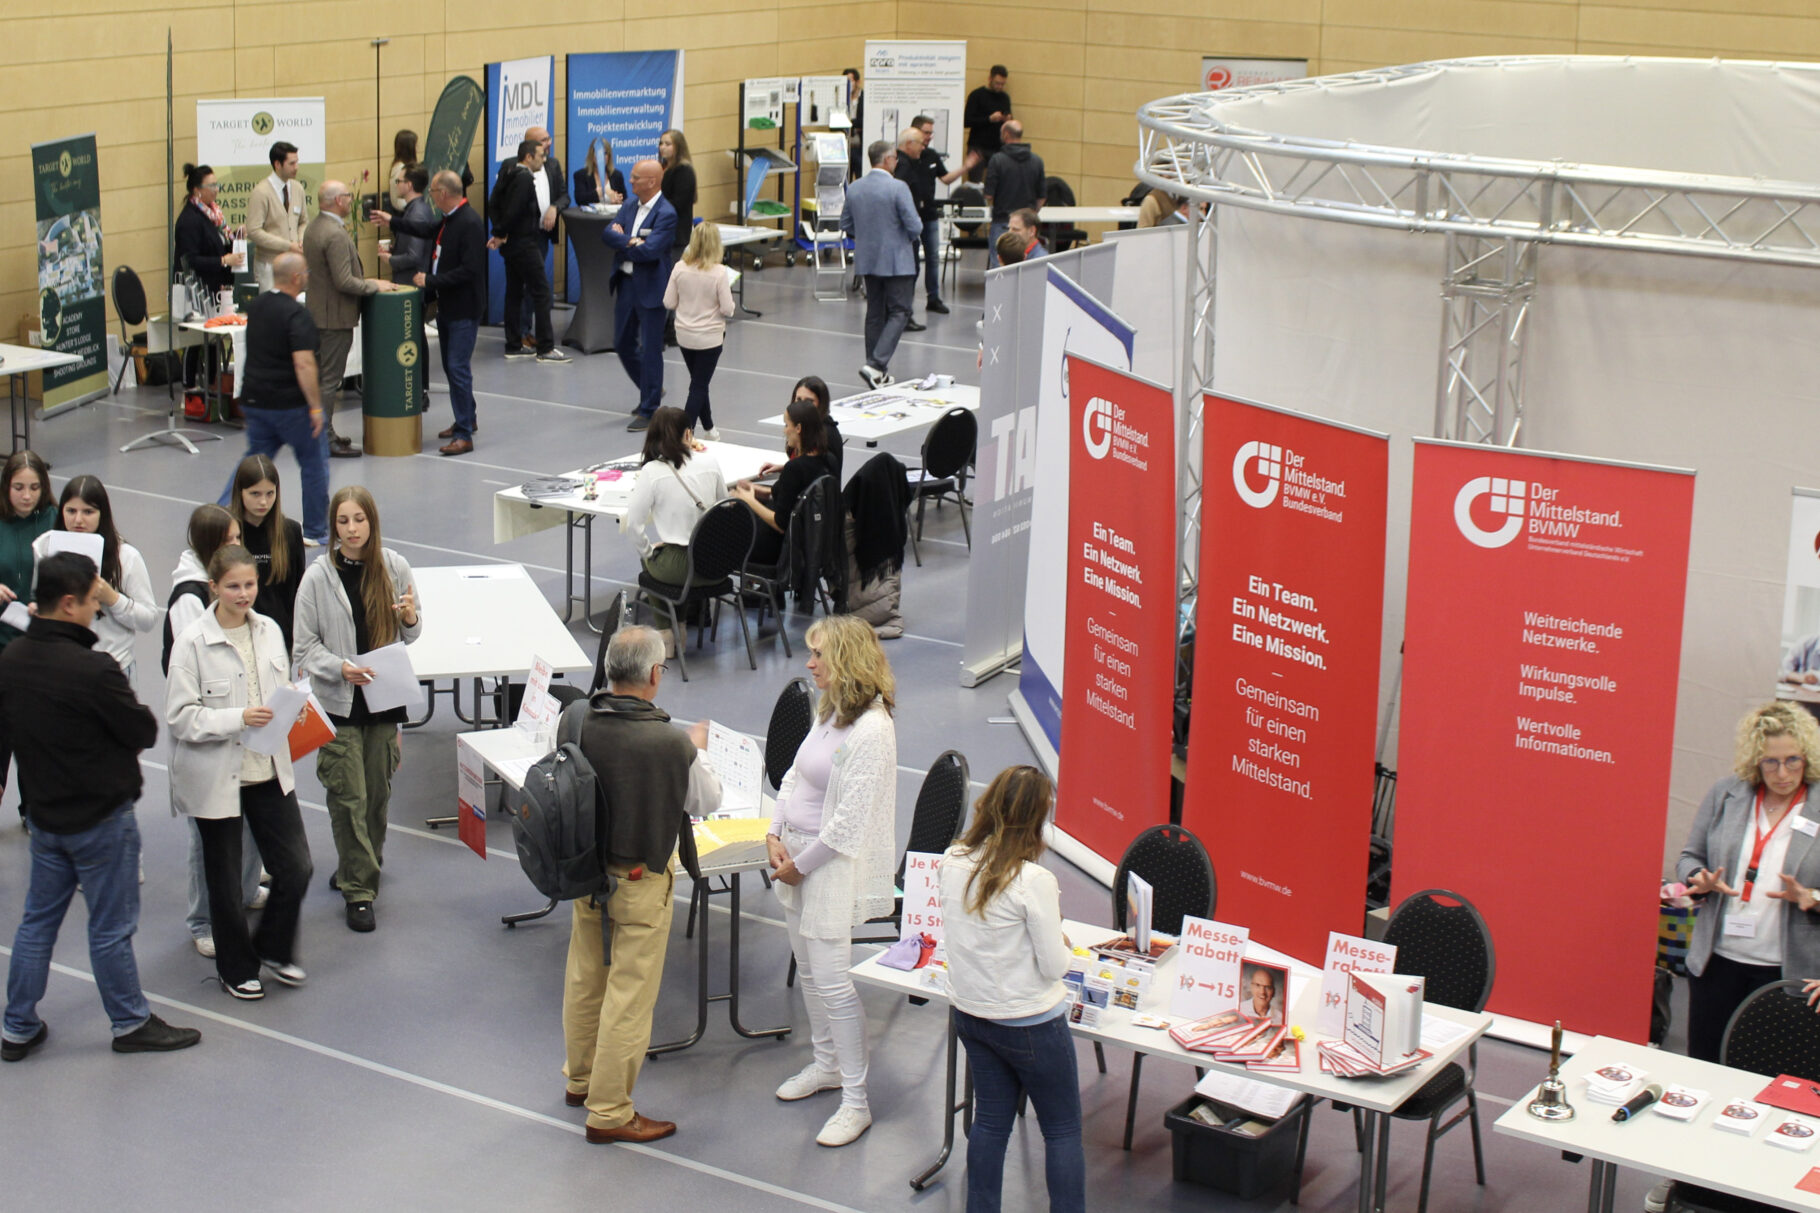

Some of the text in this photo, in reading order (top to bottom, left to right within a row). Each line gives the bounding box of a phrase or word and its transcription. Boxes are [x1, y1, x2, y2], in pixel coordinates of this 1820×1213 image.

[573, 87, 666, 100] Immobilienvermarktung
[578, 104, 664, 116] Immobilienverwaltung
[210, 118, 312, 130] TARGET WORLD
[588, 120, 662, 134] Projektentwicklung
[39, 154, 91, 174] TARGET WORLD
[219, 182, 255, 193] KARRI
[215, 198, 249, 209] PASS
[62, 312, 83, 325] ACADEMY
[66, 324, 80, 336] STORE
[404, 299, 413, 411] TARGET WORLD
[1113, 404, 1125, 421] Der
[1113, 420, 1149, 448] Mittelstand.
[1113, 435, 1129, 450] BVMW
[991, 405, 1037, 501] TA
[1113, 447, 1148, 471] Bundesverband
[1285, 449, 1305, 468] Der
[1283, 483, 1326, 505] BVMW e.V.
[1284, 466, 1346, 498] Mittelstand.
[1531, 482, 1559, 501] Der
[1283, 495, 1343, 523] Bundesverband
[1530, 500, 1623, 528] Mittelstand.
[1093, 521, 1136, 556] Ein Team.
[1529, 518, 1580, 538] BVMW
[1083, 542, 1142, 584] Ein Netzwerk.
[1084, 566, 1142, 609] Eine Mission.
[1249, 574, 1318, 613] Ein Team.
[1232, 597, 1330, 644] Ein Netzwerk.
[1524, 611, 1623, 639] Weitreichende
[1087, 617, 1139, 657] Gemeinsam
[1232, 623, 1327, 670] Eine Mission.
[1522, 629, 1600, 654] Netzwerke.
[1094, 644, 1131, 678] für einen
[1095, 673, 1128, 701] starken
[1520, 664, 1617, 692] Wirkungsvolle
[1236, 677, 1319, 722] Gemeinsam
[1519, 682, 1577, 704] Impulse.
[1086, 688, 1137, 731] Mittelstand.
[1246, 706, 1306, 744] für einen
[1517, 716, 1581, 740] Wertvolle
[1248, 738, 1300, 768] starken
[1515, 733, 1616, 764] Informationen.
[1232, 754, 1314, 800] Mittelstand.
[910, 857, 940, 870] Je K
[1240, 870, 1292, 897] www.bvmw.de
[907, 914, 922, 926] 15
[1187, 922, 1243, 946] Messe-
[1186, 943, 1239, 964] rabatt
[1333, 939, 1391, 963] Messe-
[1217, 982, 1235, 999] 15
